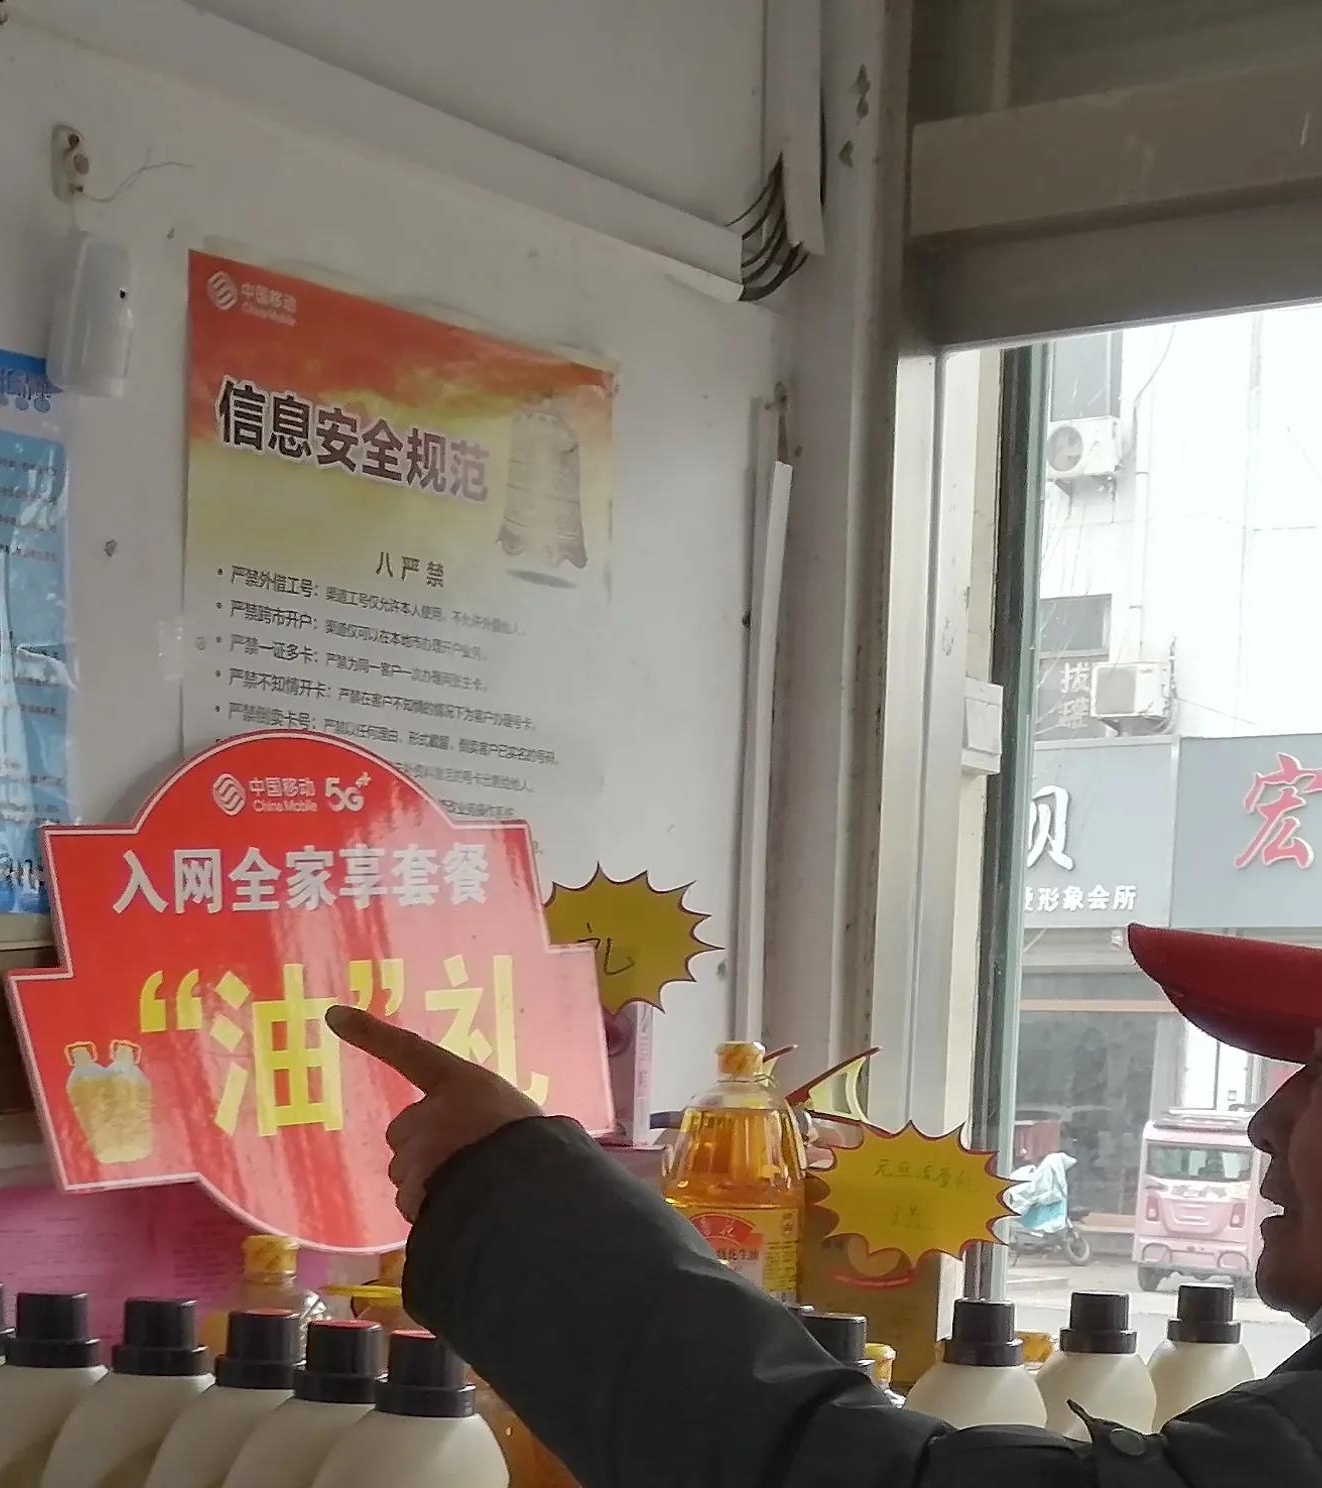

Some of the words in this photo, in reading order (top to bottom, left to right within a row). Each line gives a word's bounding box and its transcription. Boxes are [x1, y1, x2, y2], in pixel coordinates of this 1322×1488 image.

[241, 283, 297, 313] 中国移动
[218, 378, 490, 502] 信息安全规范
[249, 776, 316, 797] 中国移动
[253, 797, 281, 812] China
[283, 798, 317, 813] Mobile
[113, 844, 490, 914] 入网全家享套餐
